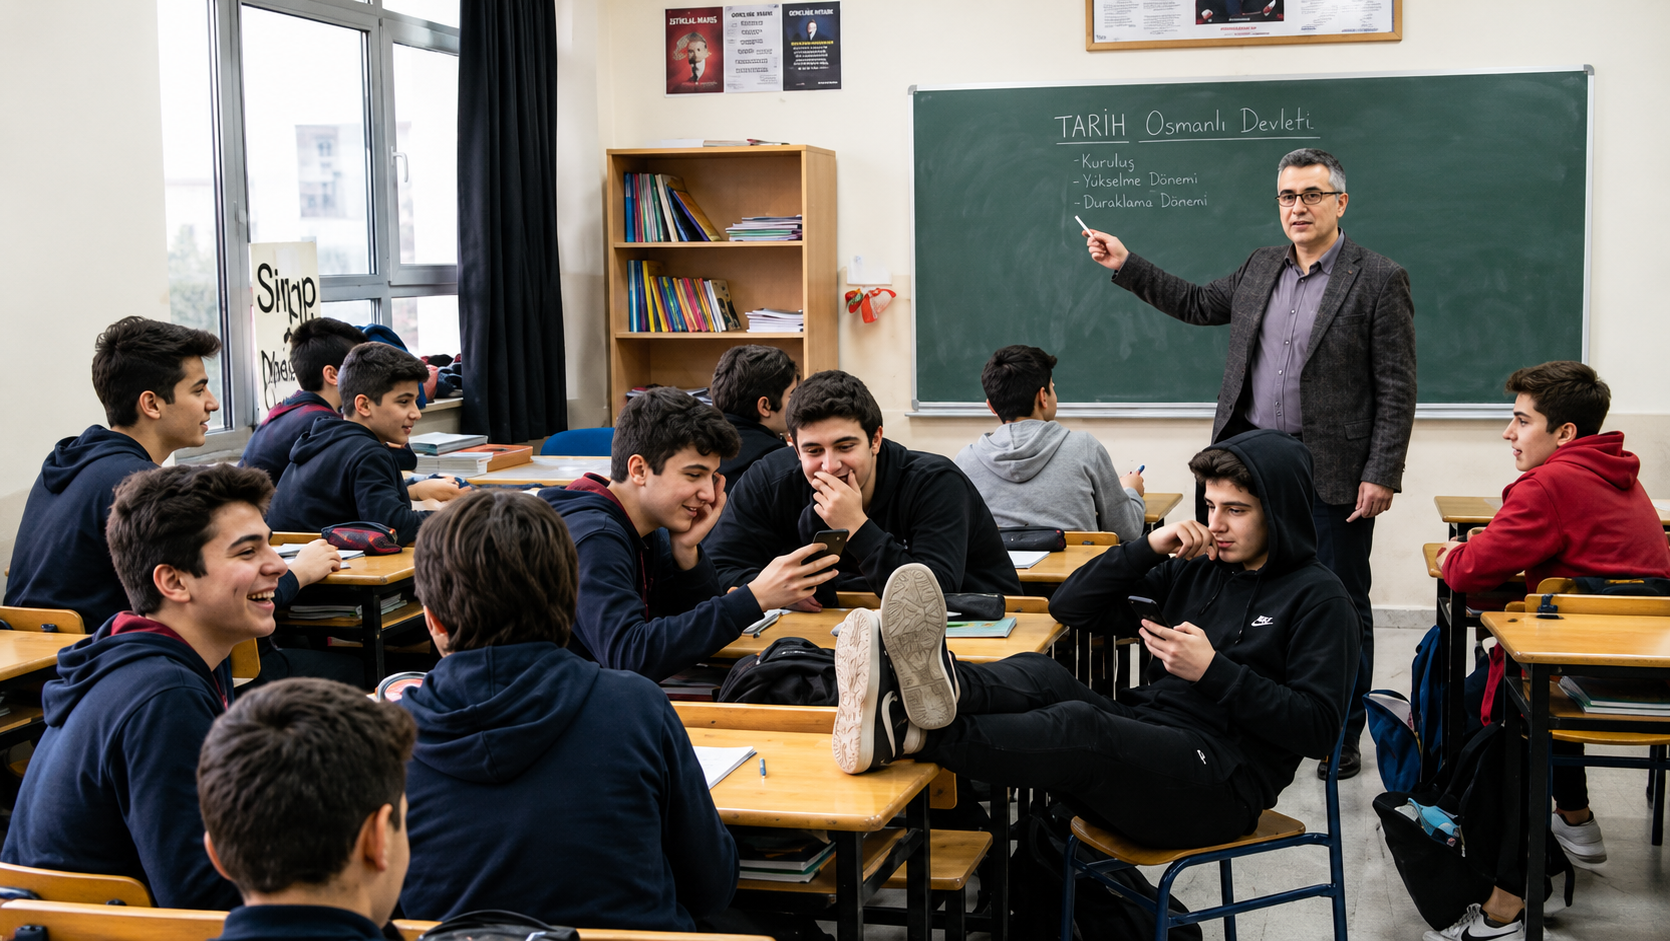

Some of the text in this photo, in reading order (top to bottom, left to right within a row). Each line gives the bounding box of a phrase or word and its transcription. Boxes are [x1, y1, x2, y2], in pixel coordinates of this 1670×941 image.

[1054, 108, 1126, 139] TARİH
[1145, 109, 1226, 136] Osmanlı
[1149, 171, 1198, 187] Dönemi
[1161, 192, 1208, 208] Dönemi
